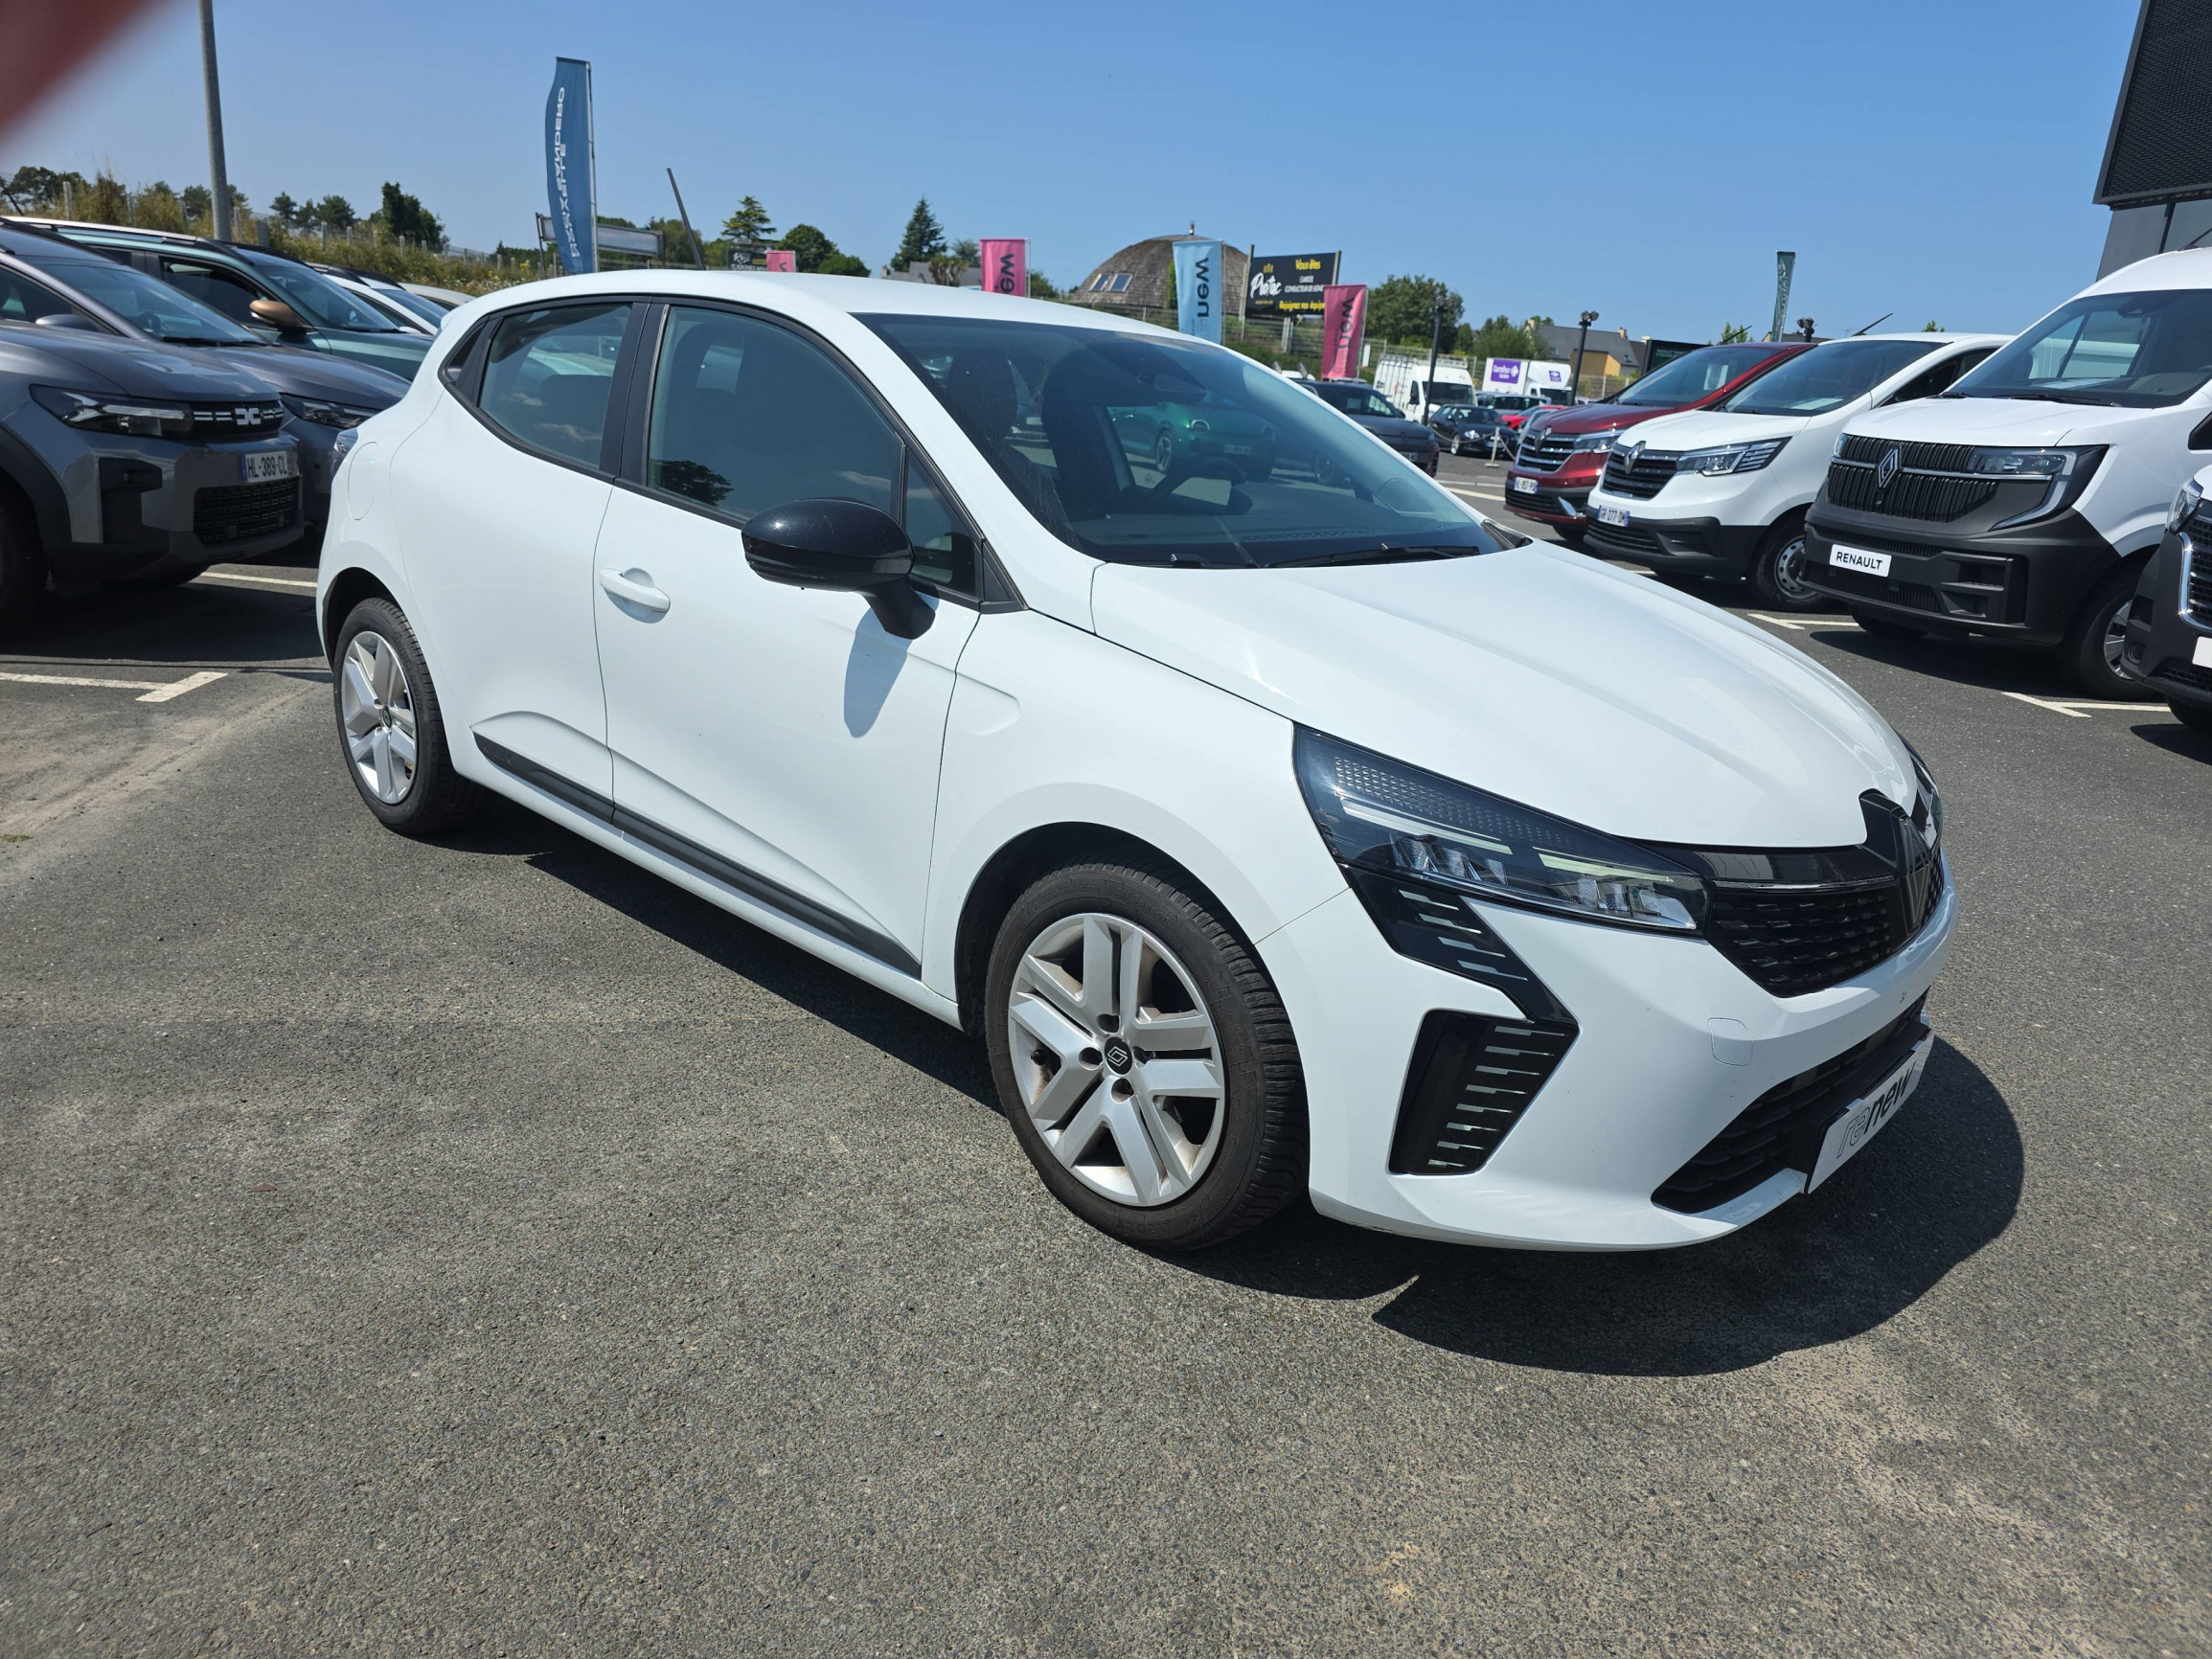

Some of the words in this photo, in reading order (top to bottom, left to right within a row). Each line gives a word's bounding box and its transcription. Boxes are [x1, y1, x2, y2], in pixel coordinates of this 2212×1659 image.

[246, 455, 288, 479] HL-389-CL
[1836, 551, 1882, 570] RENAULT
[1836, 1060, 1917, 1159] renew
